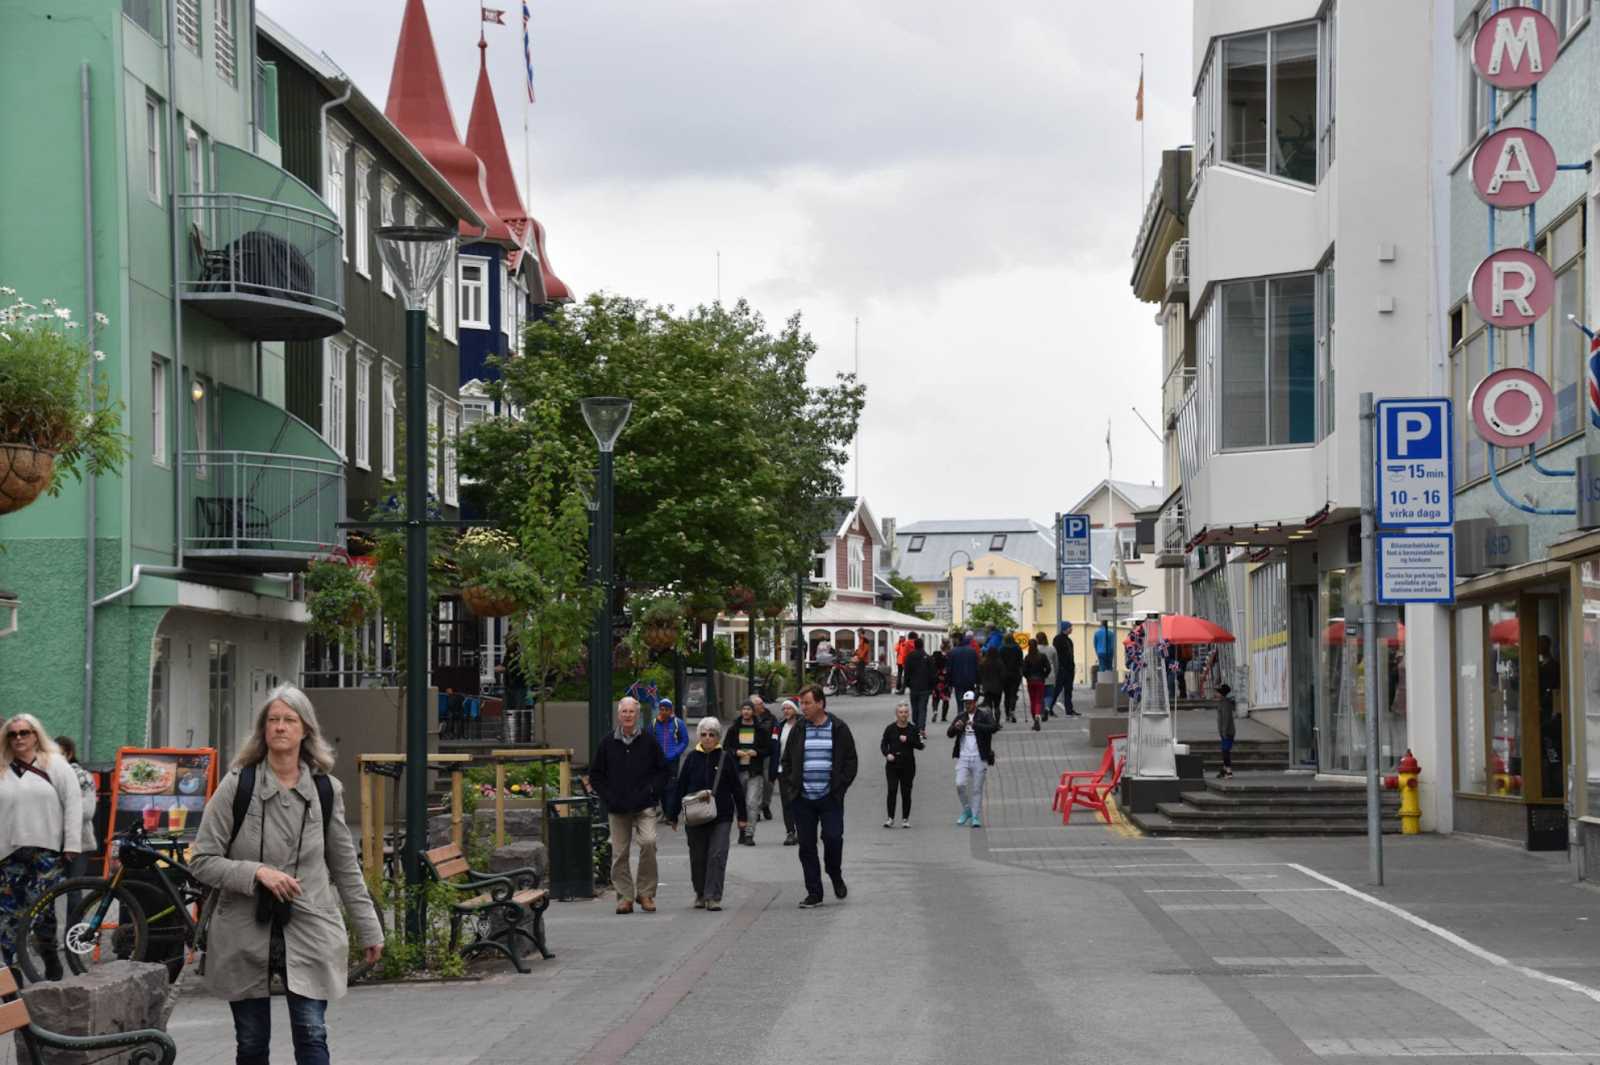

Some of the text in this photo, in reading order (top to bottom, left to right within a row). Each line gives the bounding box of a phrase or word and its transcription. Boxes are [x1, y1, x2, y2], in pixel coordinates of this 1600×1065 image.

[1483, 16, 1544, 436] MARO
[1397, 411, 1432, 456] P
[1408, 464, 1425, 478] 15
[1389, 490, 1408, 505] 10
[1423, 490, 1441, 504] 16
[1389, 508, 1441, 520] virka daga
[1069, 519, 1083, 537] P
